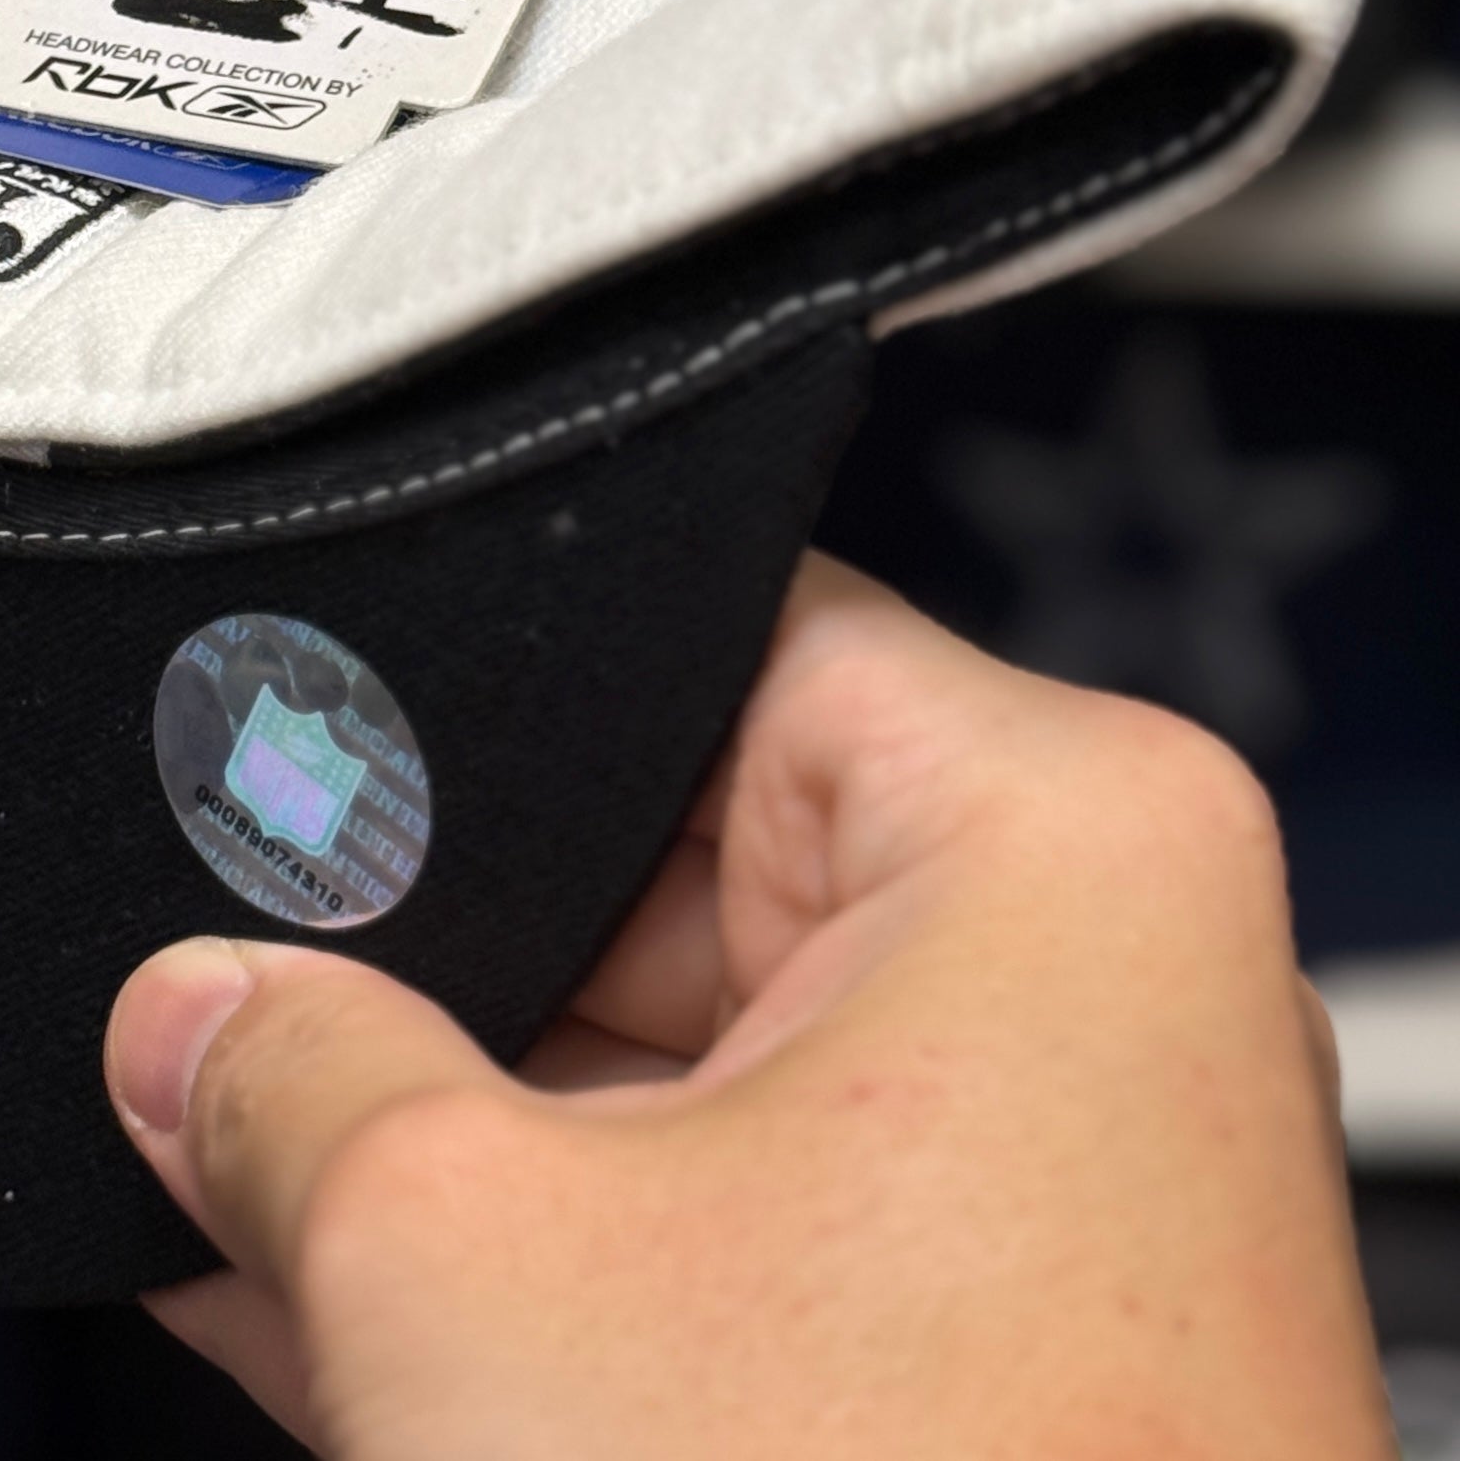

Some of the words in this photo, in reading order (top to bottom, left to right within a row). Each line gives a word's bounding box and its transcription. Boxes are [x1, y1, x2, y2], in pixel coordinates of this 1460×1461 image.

[24, 28, 162, 67] HEADWEAR
[165, 53, 322, 94] COLLECTION
[324, 79, 363, 99] BY
[194, 784, 345, 913] 00089074310
